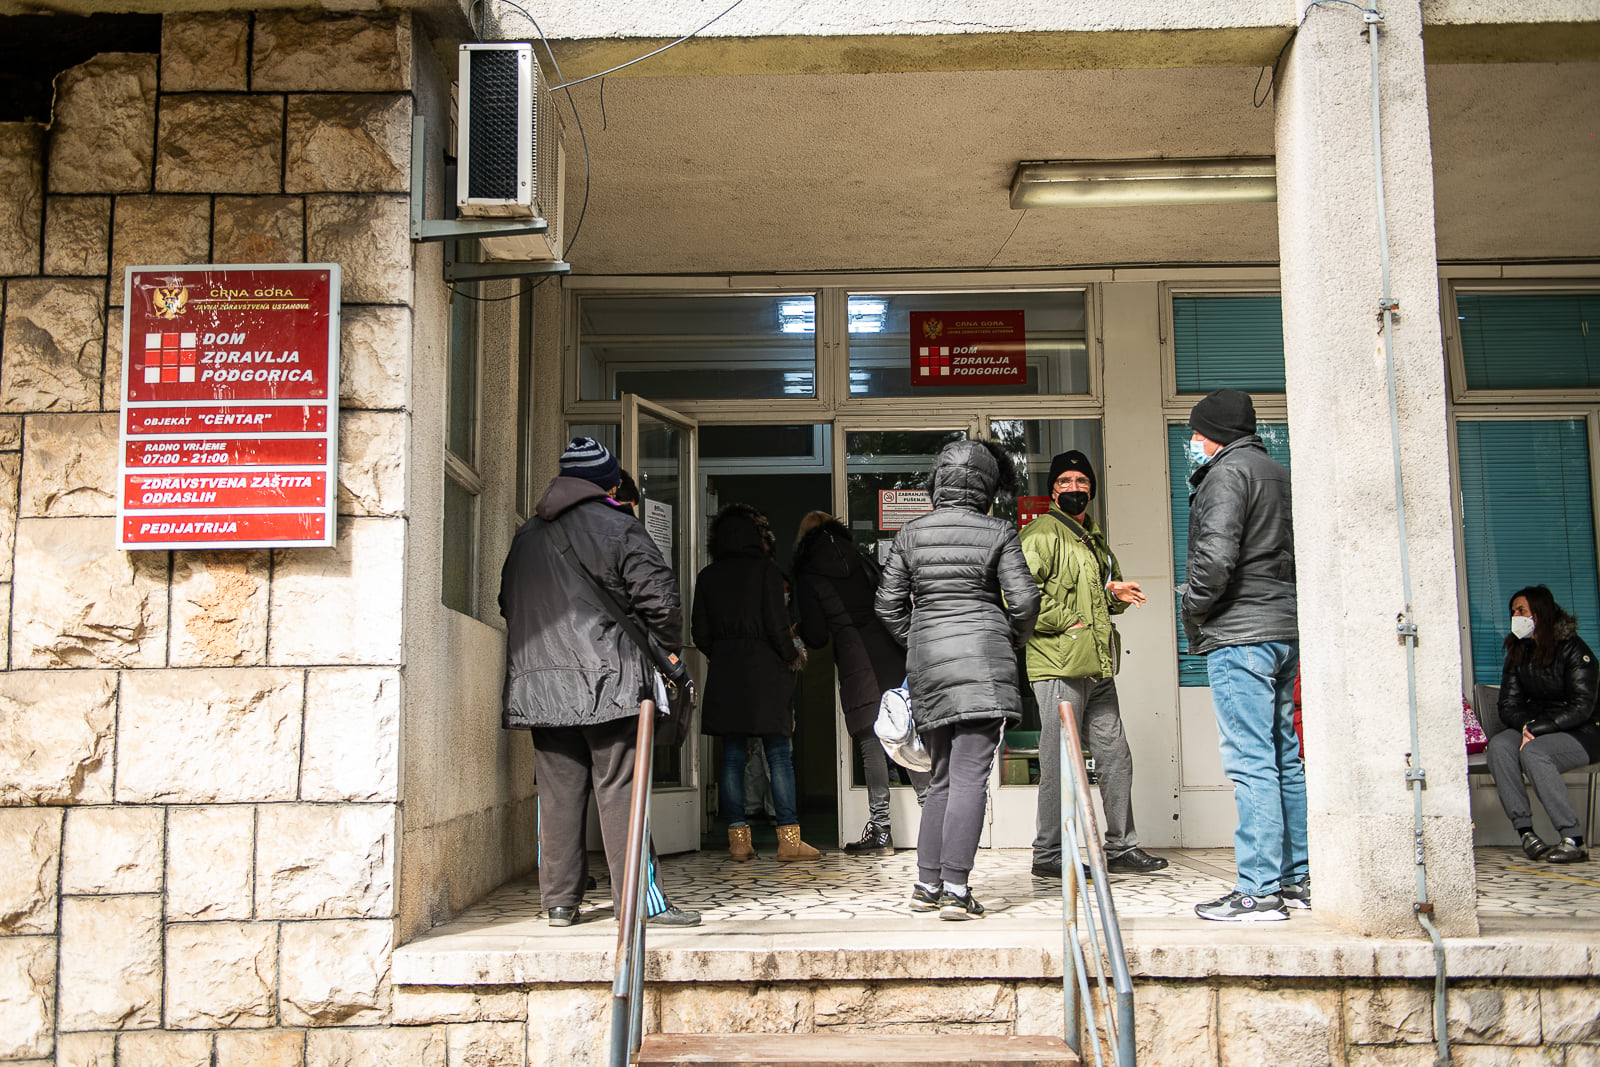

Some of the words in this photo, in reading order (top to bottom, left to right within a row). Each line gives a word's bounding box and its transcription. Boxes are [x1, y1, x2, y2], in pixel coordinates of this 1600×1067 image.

[210, 289, 249, 297] CRNA
[254, 288, 294, 297] GORA
[194, 303, 217, 311] JAVNA
[219, 303, 270, 311] ZDRAVSTVENA
[202, 332, 246, 345] DOM
[952, 346, 978, 354] DOM
[200, 351, 300, 364] ZDRAVLJA
[952, 356, 1010, 365] ZDRAVLJA
[200, 369, 313, 382] PODGORICA
[953, 367, 1018, 375] PODGORICA
[143, 417, 192, 426] OBJEKAT
[198, 413, 272, 426] "CENTAR"
[144, 443, 180, 452] RADNO
[182, 442, 227, 451] VRIJEME
[142, 453, 180, 465] 07:00
[190, 452, 229, 464] 21:00
[140, 477, 247, 490] ZDRAVSTVENA
[251, 474, 312, 489] ZAŠTITA
[142, 492, 217, 504] ODRASLIH
[140, 522, 238, 535] PEDIJATRIJA
